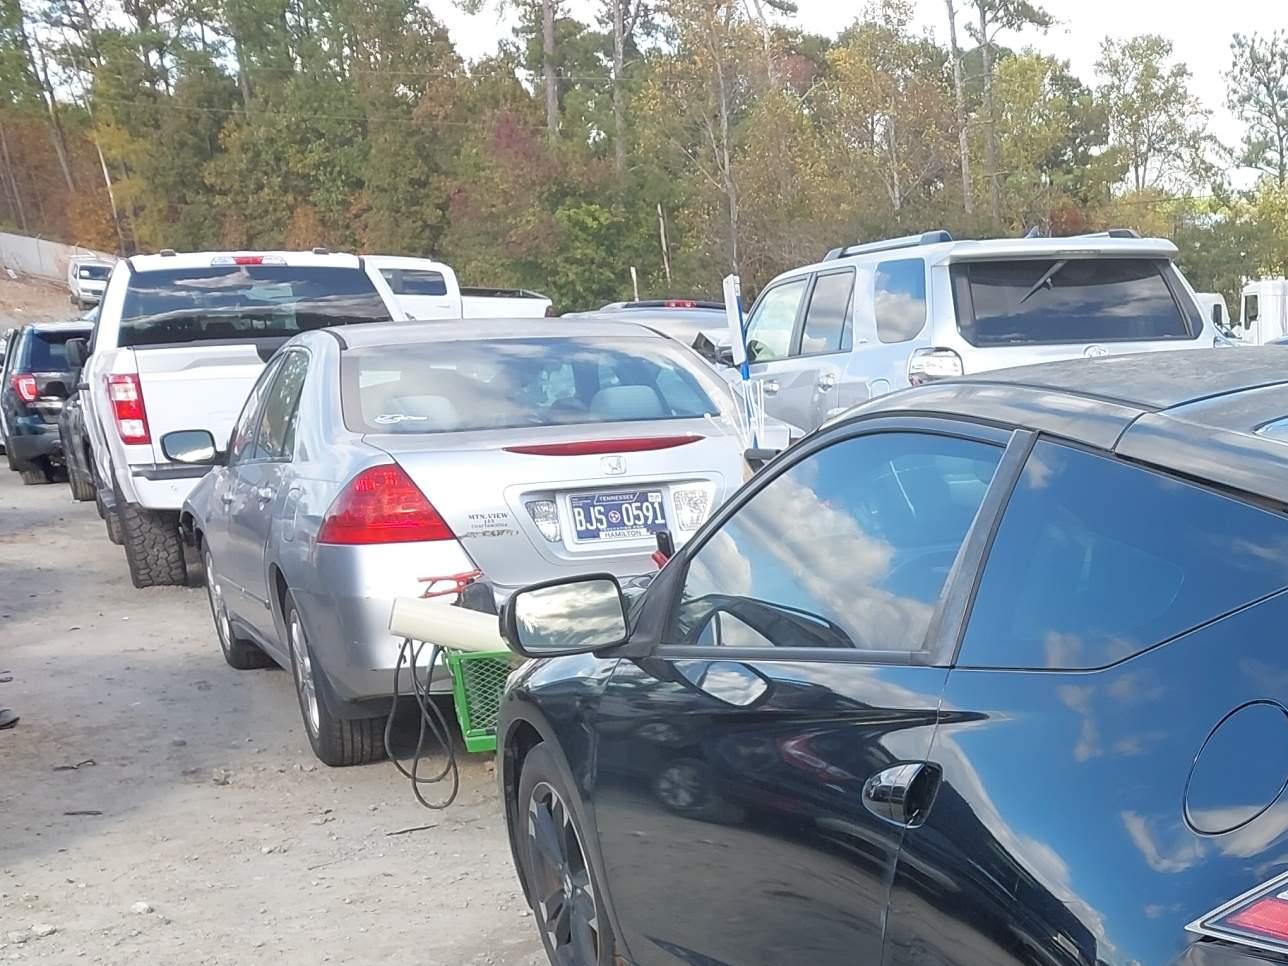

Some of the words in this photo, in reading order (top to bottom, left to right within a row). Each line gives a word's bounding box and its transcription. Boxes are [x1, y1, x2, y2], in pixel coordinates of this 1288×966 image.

[599, 494, 634, 502] TENNESSEE
[573, 505, 608, 531] BJS
[621, 501, 666, 526] 0591
[604, 530, 642, 538] HAMILTON
